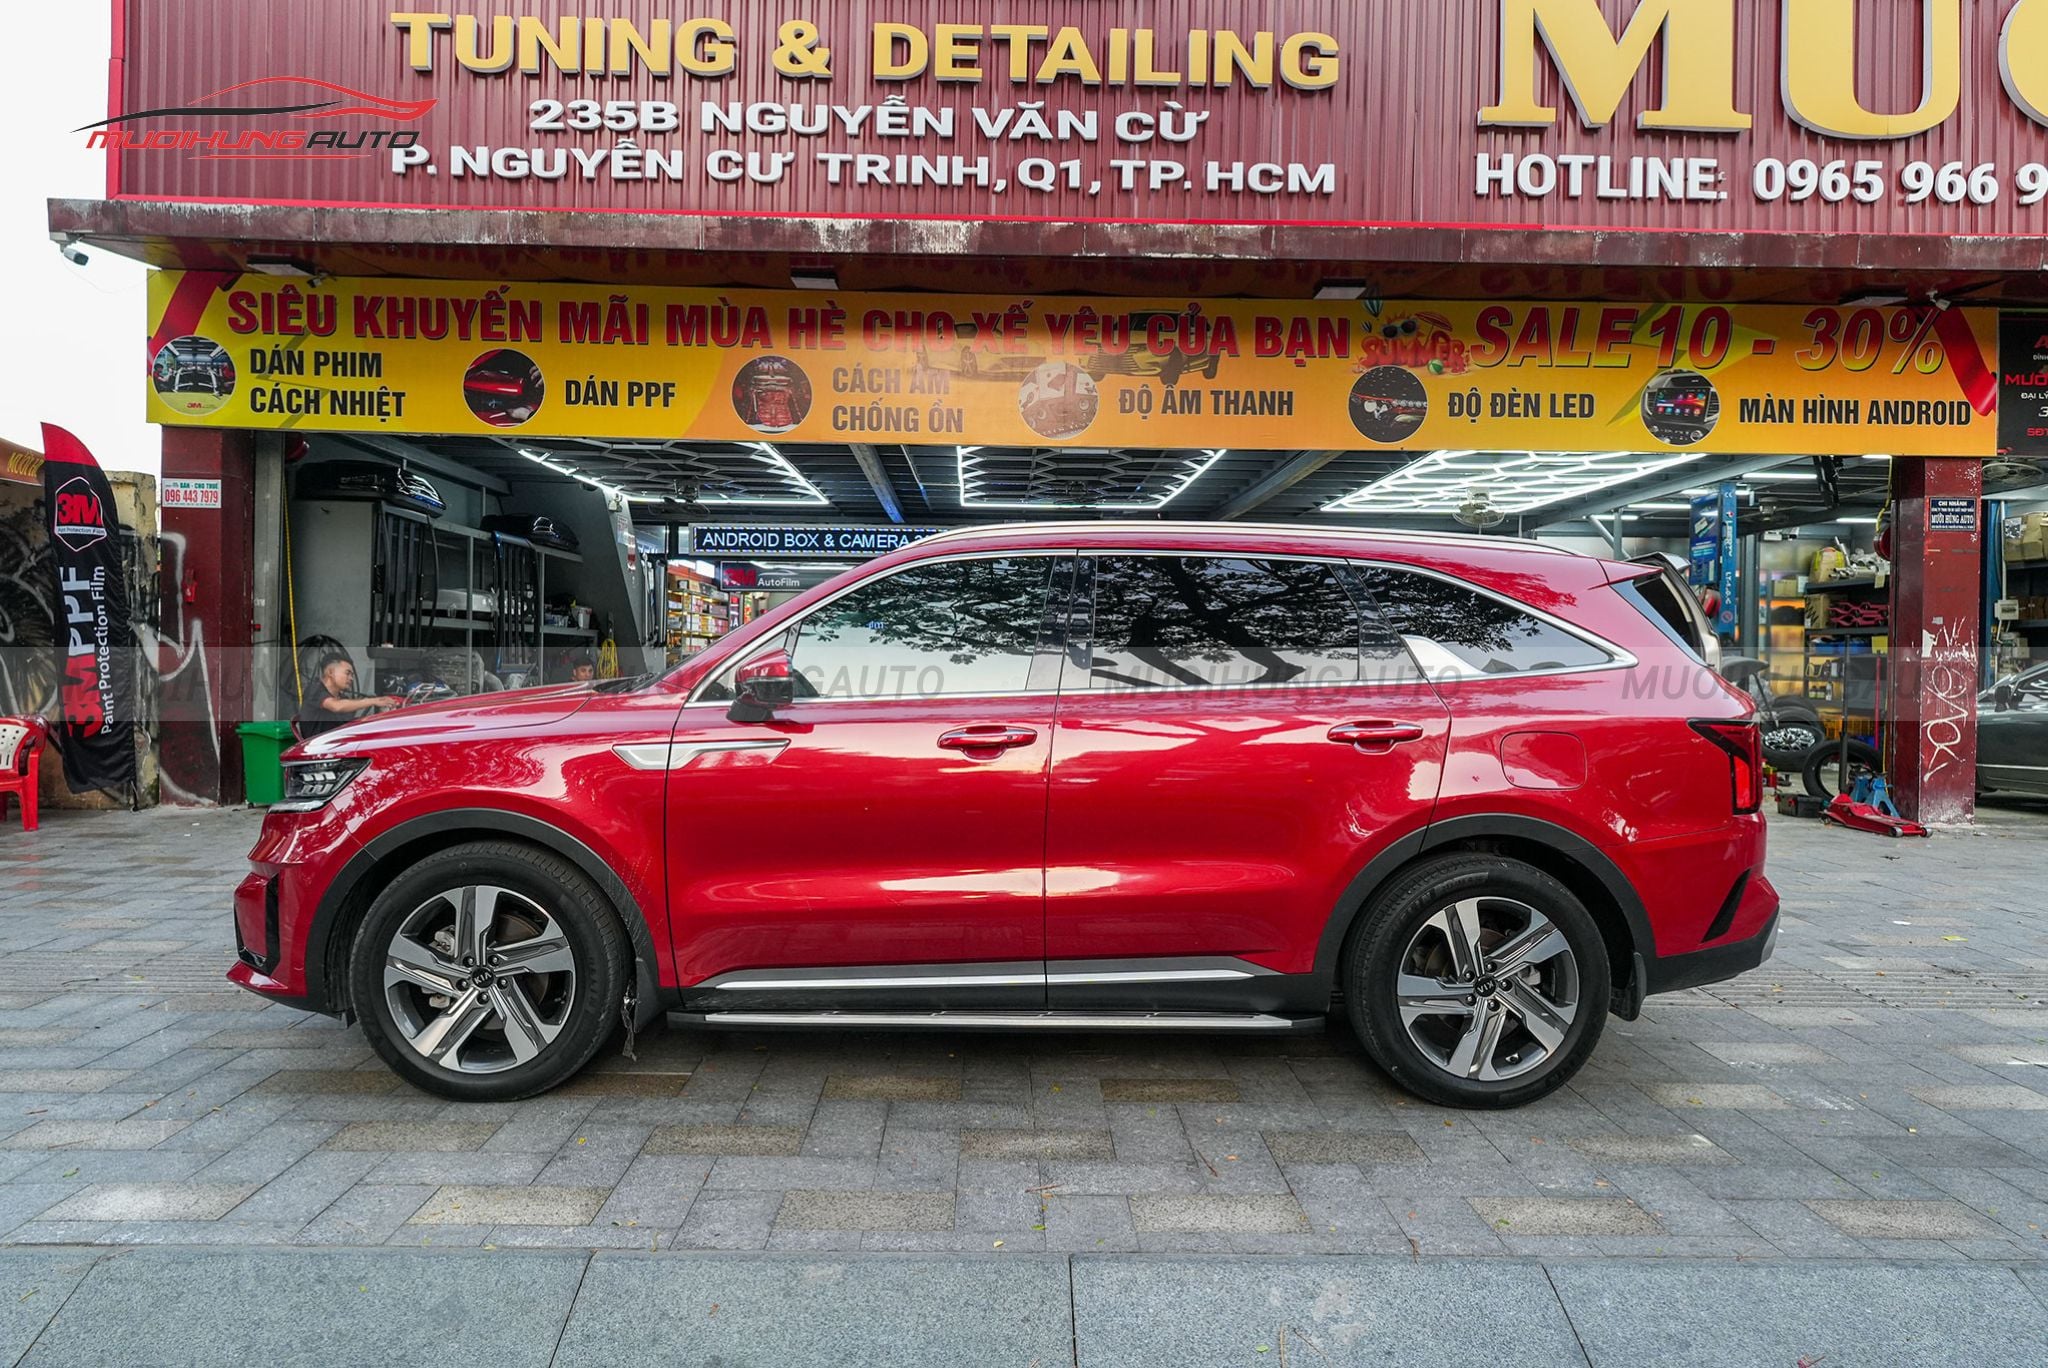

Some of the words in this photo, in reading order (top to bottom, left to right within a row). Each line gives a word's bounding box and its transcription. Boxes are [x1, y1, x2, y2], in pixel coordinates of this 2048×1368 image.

[390, 12, 737, 76] TUNING
[772, 19, 832, 79] &
[873, 22, 1340, 90] DETAILING
[529, 98, 679, 132] 235B
[701, 94, 953, 138] NGUYỄN
[971, 100, 1097, 140] VĂN
[1115, 100, 1209, 142] CỪ
[391, 145, 437, 177] P.
[450, 137, 683, 181] NGUYỄN
[706, 150, 795, 183] CƯ
[1206, 161, 1336, 194] HCM
[1475, 153, 1728, 201] HOTLINE:
[1753, 158, 1884, 203] 0965
[1901, 161, 1999, 204] 966
[227, 284, 338, 336] SIÊU
[353, 285, 542, 342] KHUYẾN
[559, 294, 650, 346] MÃI
[666, 297, 773, 348] MÙA
[788, 300, 847, 350] HÈ
[862, 309, 957, 354] CHO
[971, 300, 1034, 354] XẾ
[1045, 306, 1131, 355] YÊU
[1147, 302, 1241, 357] CỦA
[1254, 316, 1350, 367] BẠN
[1470, 305, 1639, 368] SALE
[1650, 305, 1734, 369] 10
[1752, 339, 1776, 355] -
[1795, 307, 1945, 374] 30%
[250, 344, 304, 376] DÁN
[314, 351, 382, 378] PHIM
[832, 362, 901, 394] CÁCH
[250, 383, 321, 415] CÁCH
[330, 386, 406, 422] NHIỆT
[565, 375, 619, 406] DÁN
[627, 382, 676, 408] PPF
[1118, 384, 1153, 420] ĐỘ
[1161, 384, 1201, 415] ÂM
[1210, 390, 1293, 416] THANH
[1448, 387, 1482, 423] ĐỘ
[1490, 387, 1541, 418] ĐÈN
[1550, 393, 1594, 418] LED
[1739, 393, 1794, 424] MÀN
[1803, 394, 1859, 424] HÌNH
[1867, 400, 1971, 426] ANDROID
[832, 397, 919, 433] CHỐNG
[929, 399, 963, 433] ỒN
[57, 492, 103, 527] 3M
[165, 489, 181, 502] 096
[183, 490, 198, 503] 443
[200, 490, 218, 504] 7979
[703, 532, 779, 547] ANDROID
[784, 533, 819, 547] BOX
[824, 534, 835, 547] &
[839, 534, 909, 549] CAMERA
[90, 566, 105, 600] Film
[724, 567, 757, 587] 3M
[757, 577, 800, 587] AutoFilm
[94, 604, 111, 690] Protection
[101, 691, 115, 734] Paint
[474, 972, 492, 984] KIA
